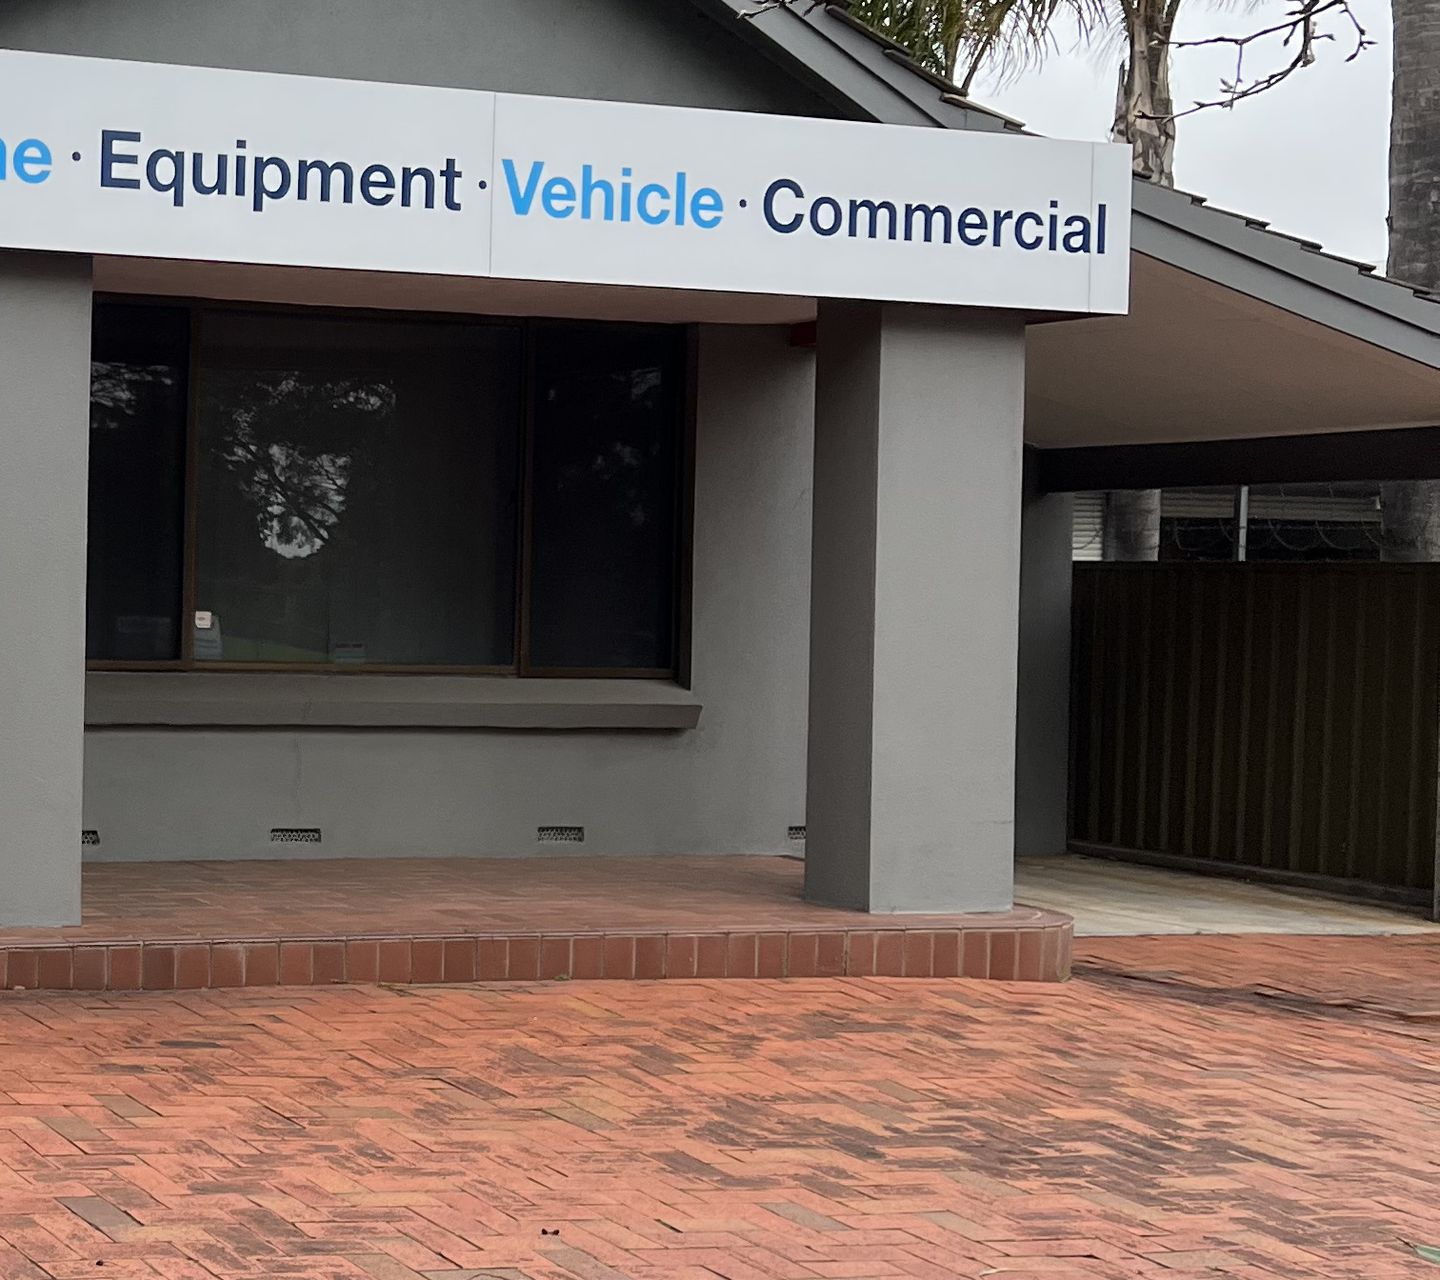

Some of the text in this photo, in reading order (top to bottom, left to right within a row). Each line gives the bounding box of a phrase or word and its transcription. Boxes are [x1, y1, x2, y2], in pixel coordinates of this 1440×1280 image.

[99, 128, 464, 214] Equipment
[501, 158, 725, 230] Vehicle
[762, 177, 1108, 256] Commercial
